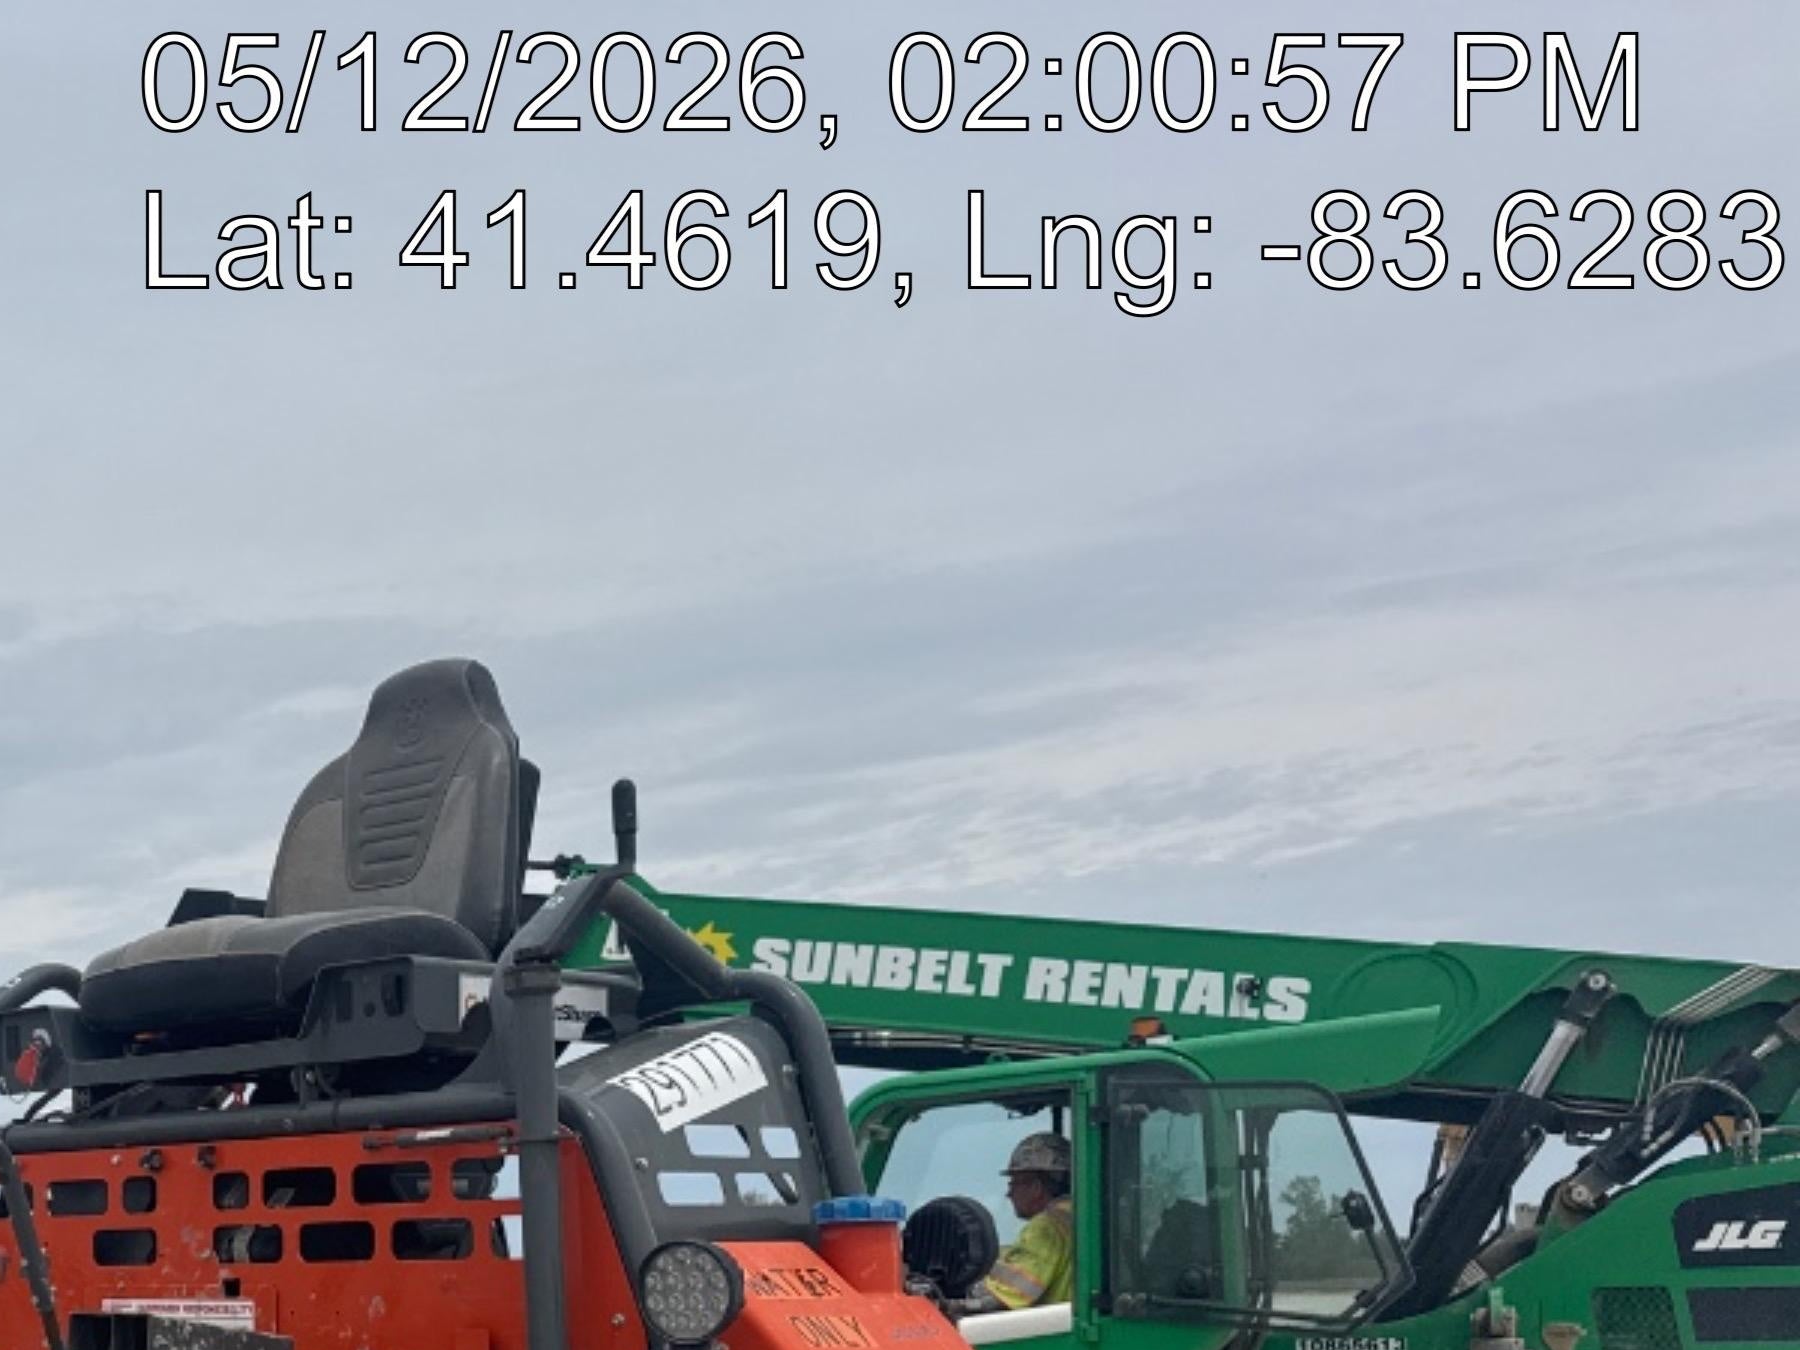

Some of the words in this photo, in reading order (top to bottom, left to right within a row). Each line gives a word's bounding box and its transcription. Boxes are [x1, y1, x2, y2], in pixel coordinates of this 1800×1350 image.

[750, 937, 1014, 998] SUNBELT
[1024, 956, 1312, 1022] RENTALS
[1692, 1220, 1787, 1252] JLG
[788, 1315, 871, 1348] ONLY
